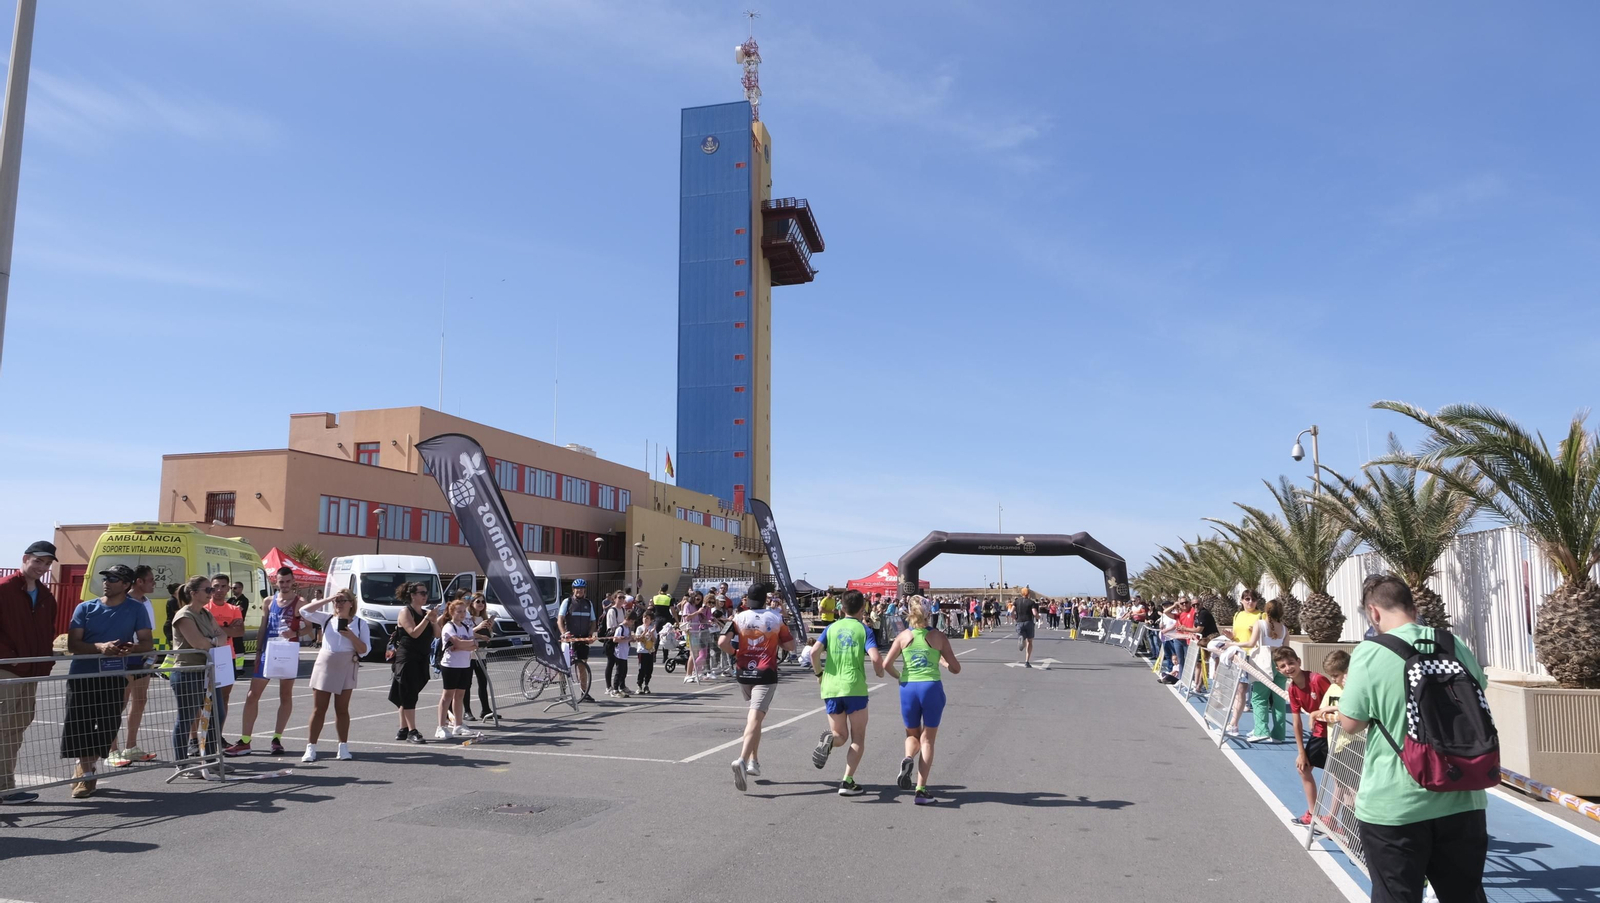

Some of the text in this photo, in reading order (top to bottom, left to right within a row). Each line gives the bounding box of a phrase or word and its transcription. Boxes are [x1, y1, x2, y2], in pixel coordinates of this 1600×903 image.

[106, 534, 182, 543] AMBULANCIA
[102, 545, 181, 554] SOPORTE VITAL AVANZADO
[158, 567, 165, 575] U
[154, 574, 166, 582] 24
